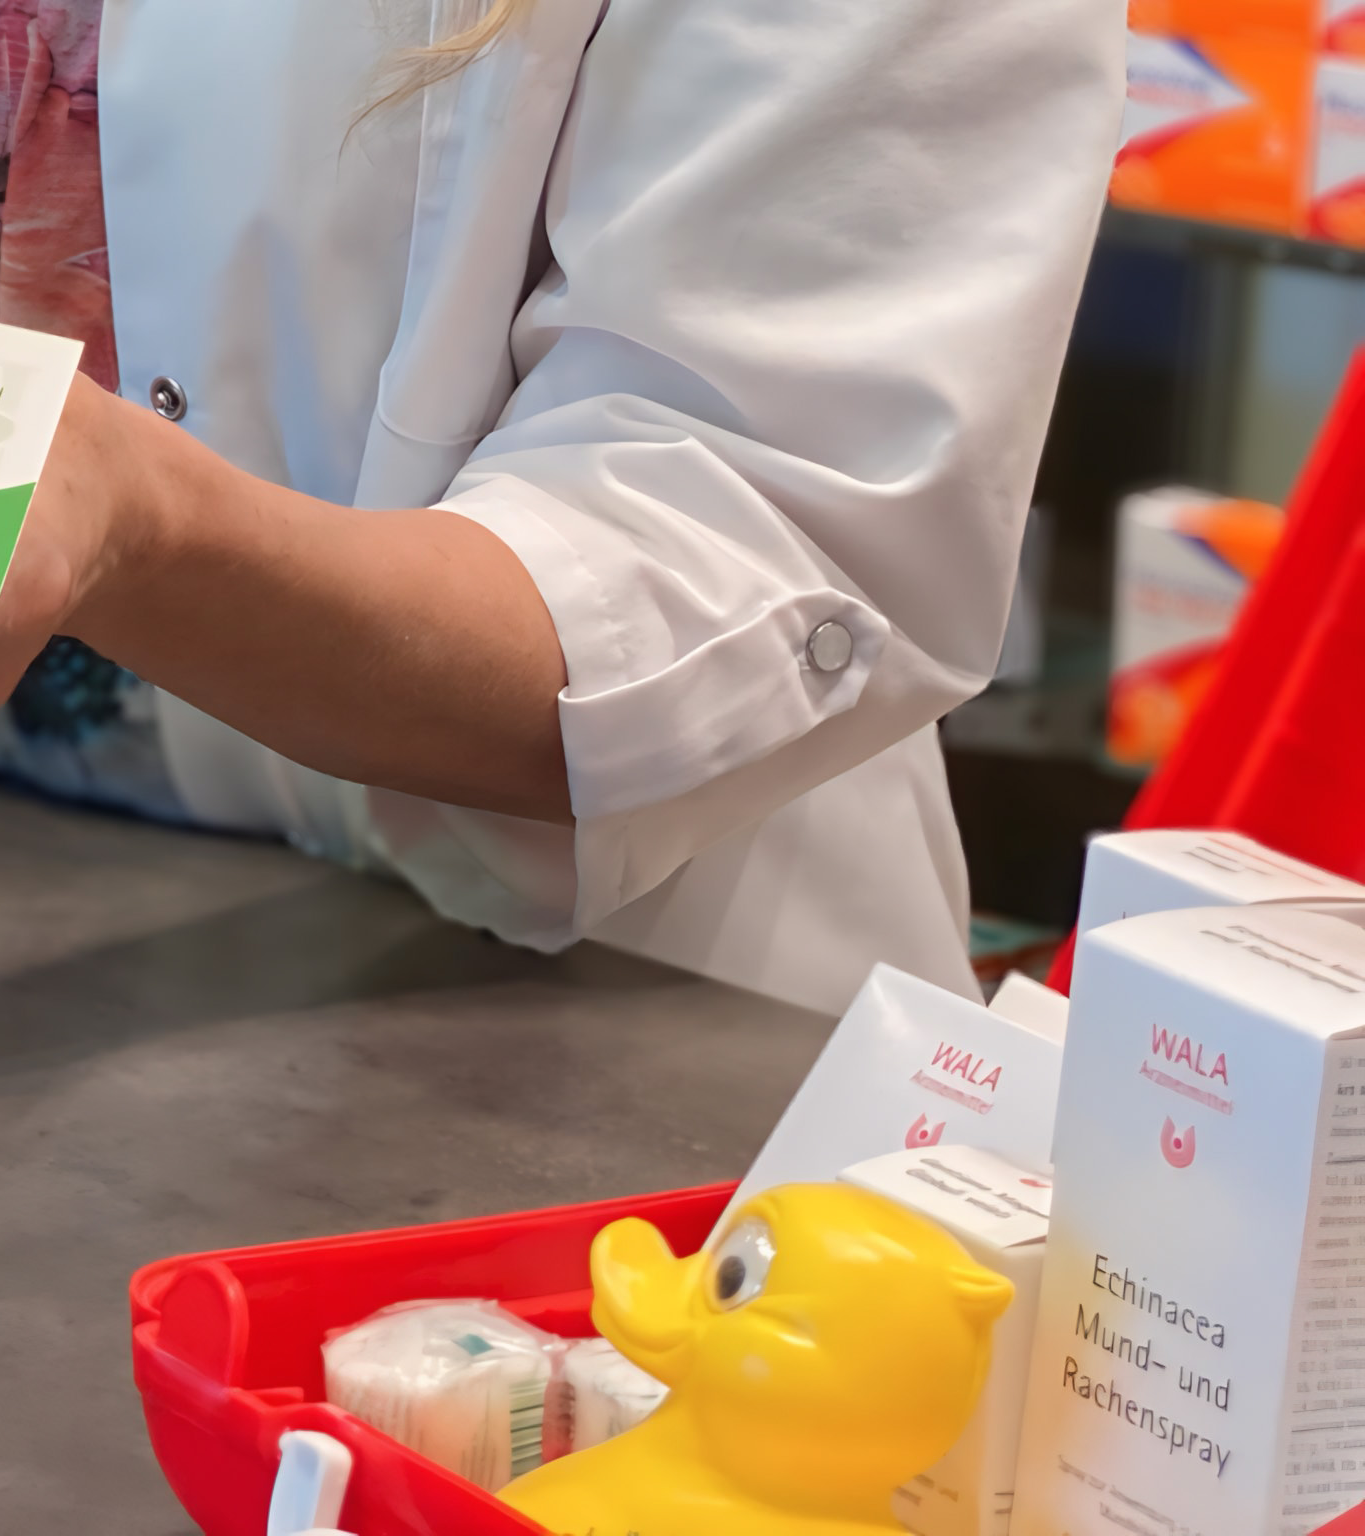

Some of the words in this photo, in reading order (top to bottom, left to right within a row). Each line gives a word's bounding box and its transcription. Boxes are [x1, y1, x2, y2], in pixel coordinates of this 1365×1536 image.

[930, 1040, 1003, 1093] WALA
[1153, 1023, 1229, 1086] WALA
[1092, 1252, 1226, 1349] Echinacea
[1075, 1302, 1167, 1372] Mund-
[1178, 1366, 1231, 1412] und
[1062, 1355, 1231, 1478] Rachenspray
